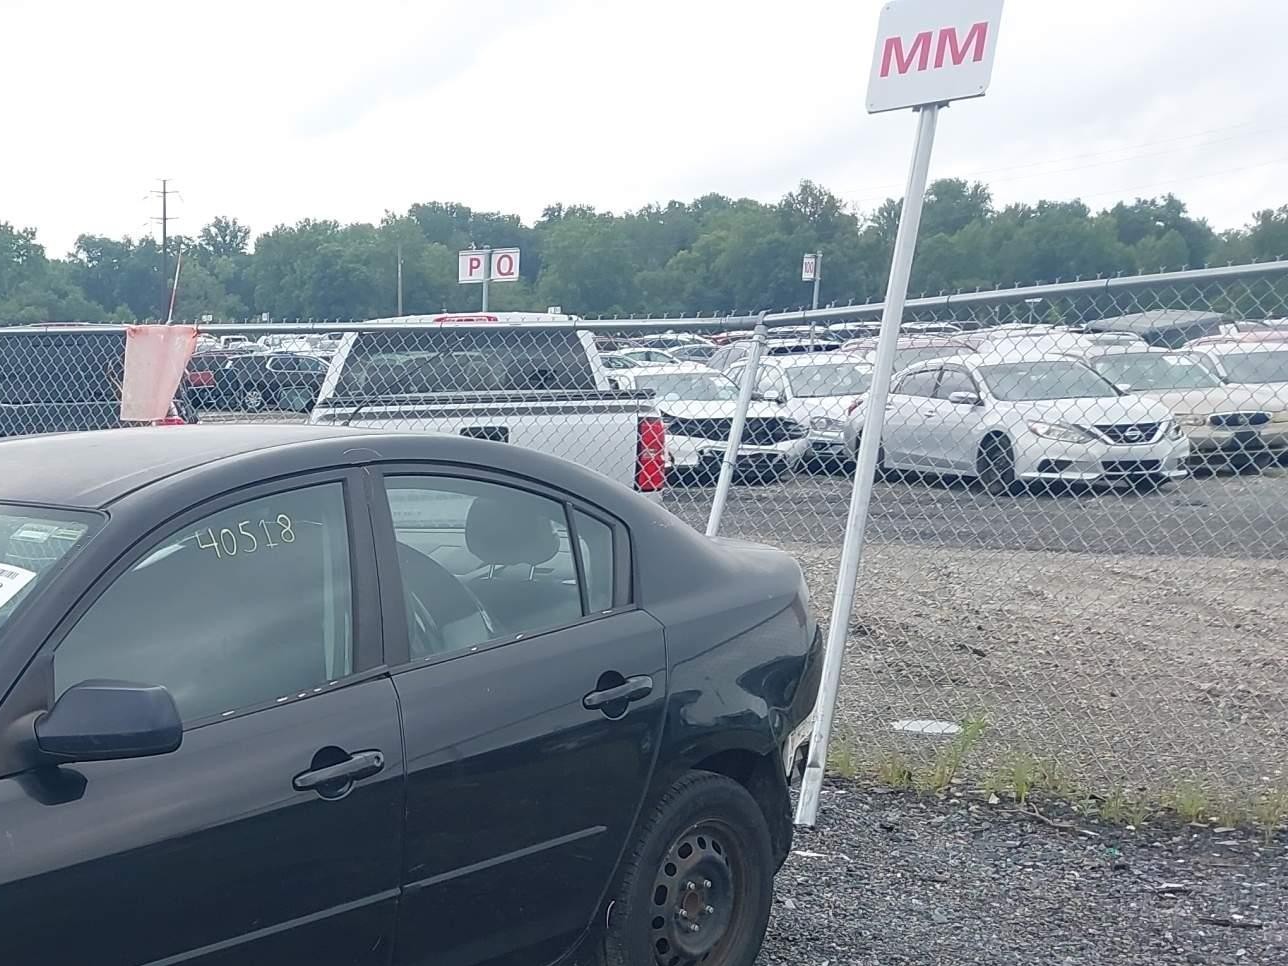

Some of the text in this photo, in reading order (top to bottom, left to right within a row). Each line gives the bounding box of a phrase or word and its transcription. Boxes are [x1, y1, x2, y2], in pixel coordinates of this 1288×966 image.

[880, 22, 988, 77] MM
[469, 257, 481, 277] P
[496, 254, 514, 277] Q
[195, 514, 295, 559] 40518
